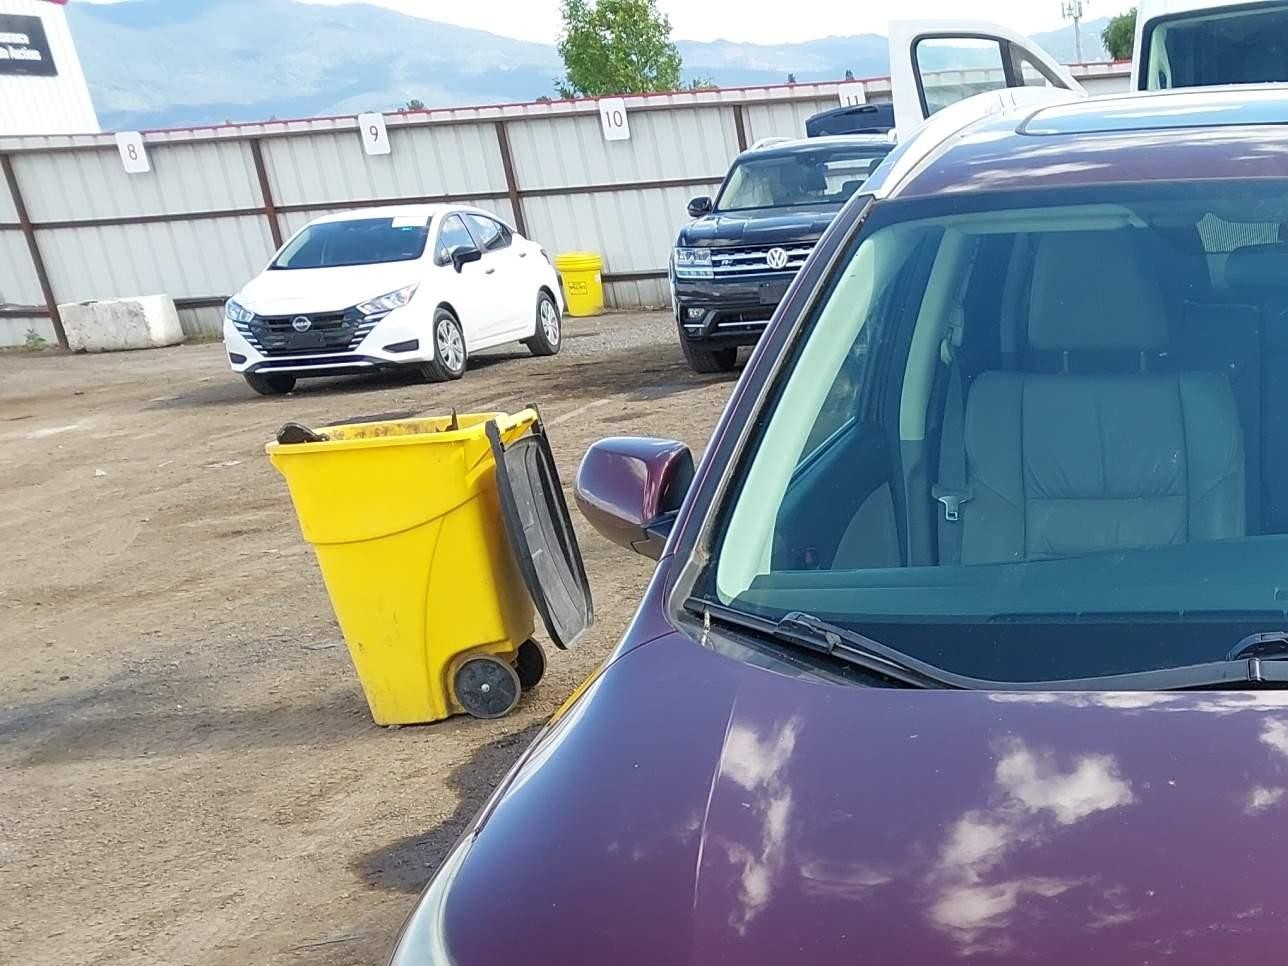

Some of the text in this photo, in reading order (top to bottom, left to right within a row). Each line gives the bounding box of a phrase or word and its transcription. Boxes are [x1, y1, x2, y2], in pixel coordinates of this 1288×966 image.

[604, 110, 624, 129] 10
[368, 125, 379, 143] 9
[127, 143, 138, 161] 8
